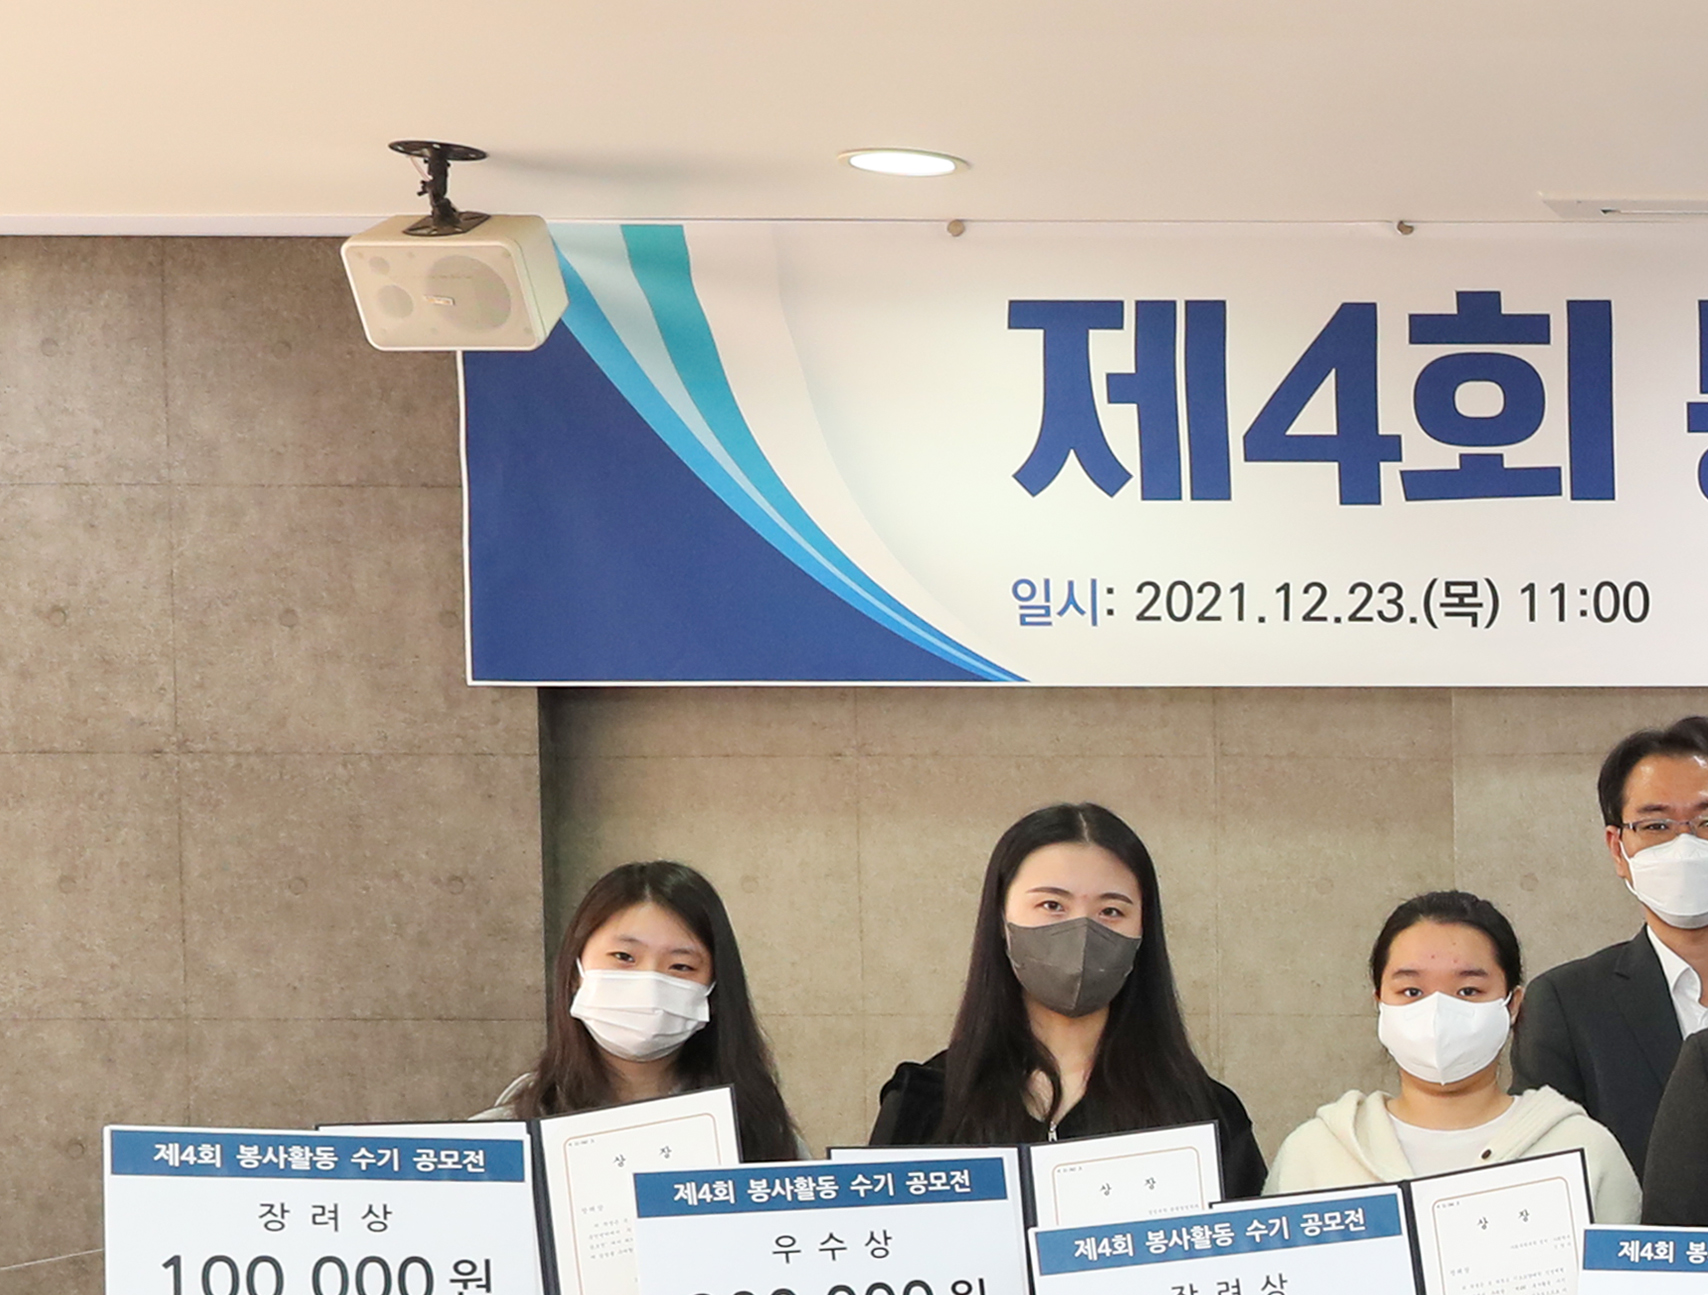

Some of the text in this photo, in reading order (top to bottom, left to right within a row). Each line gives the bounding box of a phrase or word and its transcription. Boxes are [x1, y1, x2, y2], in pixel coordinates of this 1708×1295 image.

[1007, 290, 1616, 506] 제4회
[1011, 578, 1115, 627] 일시:
[1136, 577, 1500, 629] 2021.12.23.(목)
[1520, 580, 1650, 623] 11:00
[153, 1142, 485, 1173] 제4회 봉사활동 수기 공모전
[673, 1169, 971, 1206] 제4회 봉사활동 수기 공모전
[1074, 1207, 1366, 1261] 제4회 봉사활동 수기 공모전
[1617, 1240, 1674, 1264] 제4회
